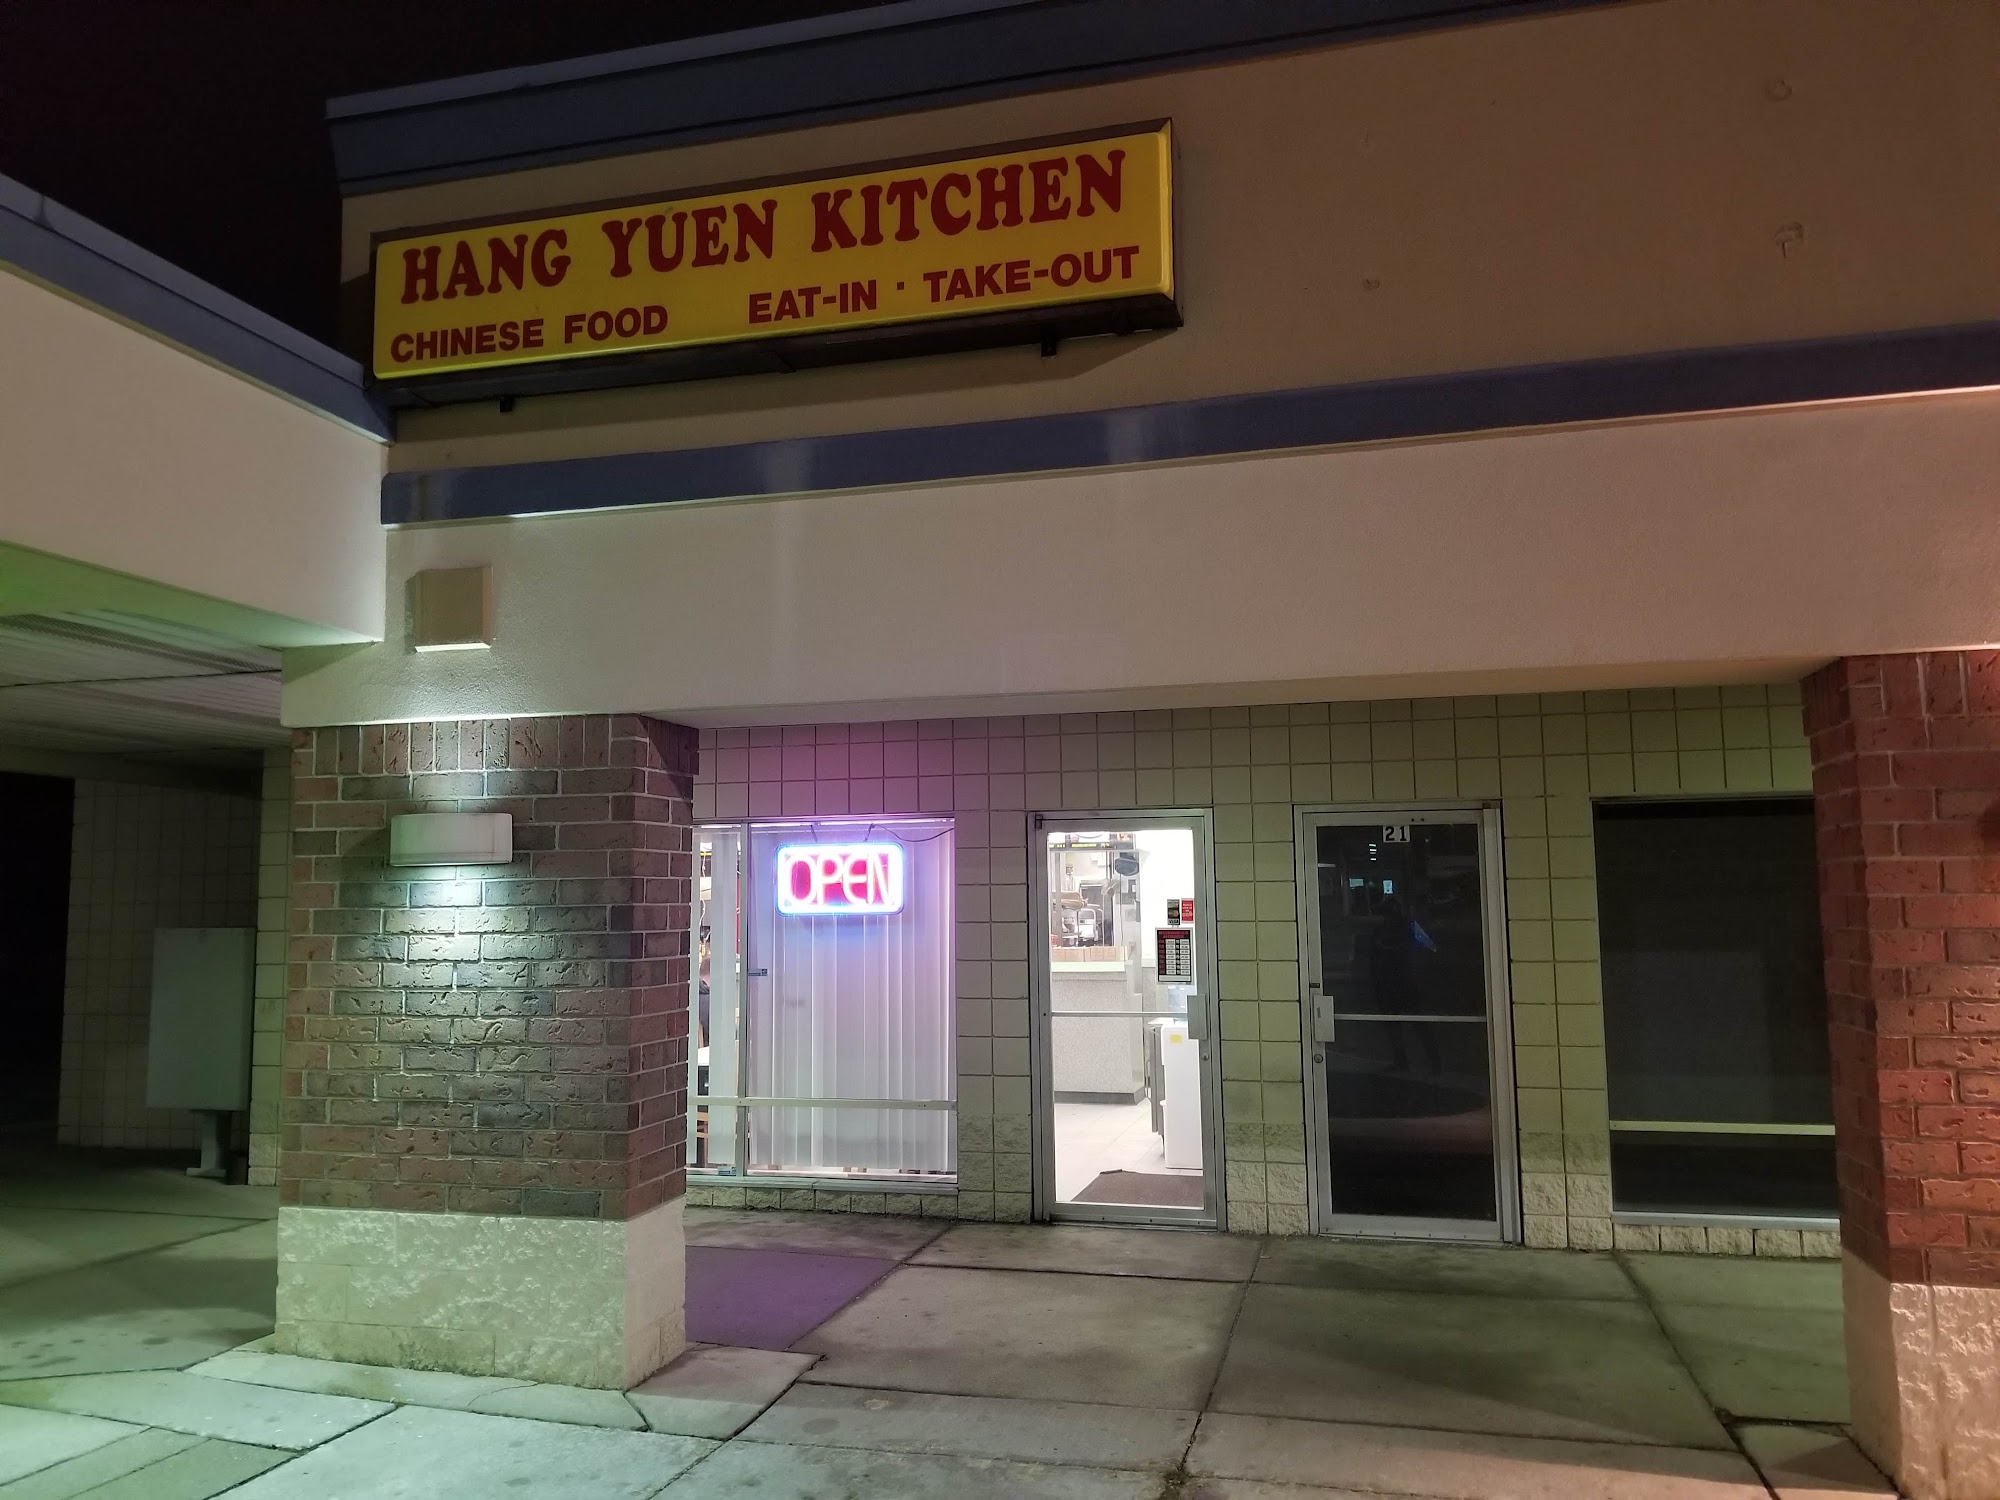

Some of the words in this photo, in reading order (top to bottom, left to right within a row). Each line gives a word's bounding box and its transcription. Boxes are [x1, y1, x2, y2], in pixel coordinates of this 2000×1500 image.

[401, 229, 571, 304] HANG
[602, 199, 778, 278] YUEN
[811, 149, 1126, 253] KITCHEN
[748, 279, 877, 324] EAT-IN
[923, 245, 1140, 303] TAKE-OUT
[391, 318, 544, 363] CHINESE
[564, 305, 668, 344] FOOD
[1384, 825, 1407, 842] 21
[785, 852, 893, 905] OPEN
